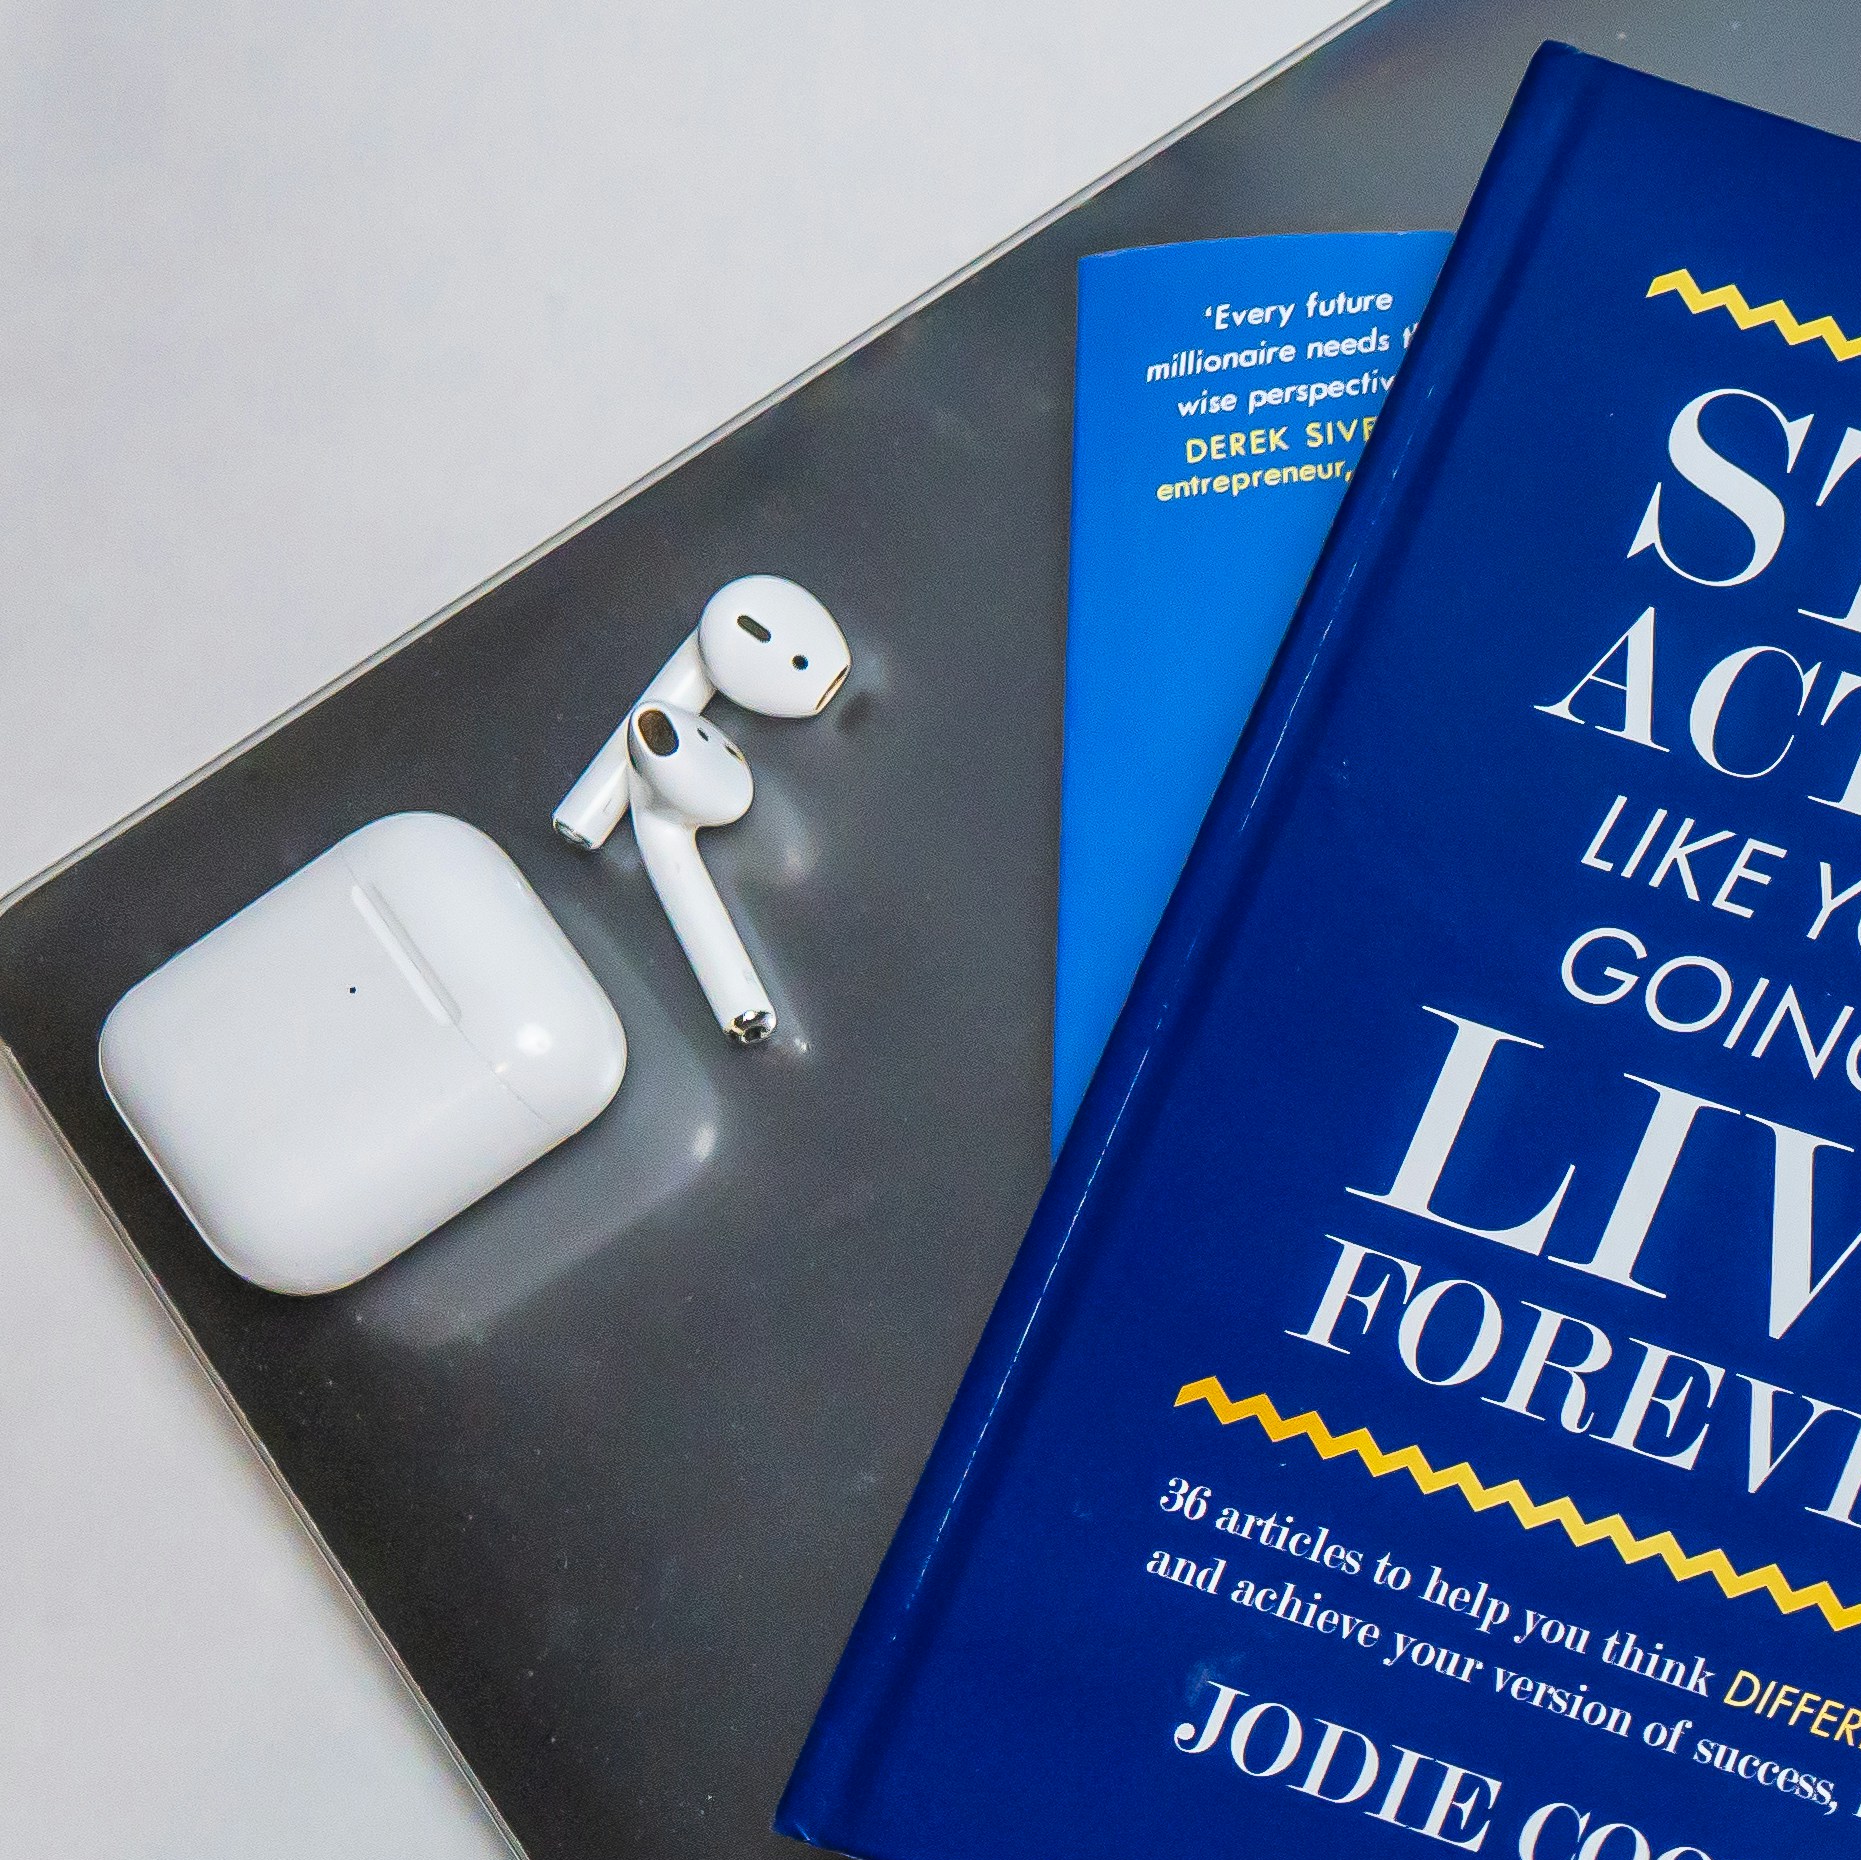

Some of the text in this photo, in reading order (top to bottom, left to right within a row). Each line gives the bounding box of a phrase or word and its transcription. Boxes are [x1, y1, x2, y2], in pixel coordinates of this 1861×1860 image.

[1306, 291, 1393, 318] future
[1146, 340, 1296, 383] millionaire
[1306, 327, 1391, 359] needs
[1178, 369, 1397, 417] wise perspectiv
[1185, 427, 1290, 463] DEREK
[1581, 795, 1788, 919] LIKE
[1159, 1475, 1211, 1522] 36
[1215, 1507, 1362, 1575] articles
[1377, 1552, 1412, 1591] to
[1422, 1565, 1511, 1632] help
[1514, 1607, 1592, 1655] you
[1602, 1629, 1716, 1699] think
[1145, 1548, 1220, 1595] and
[1230, 1577, 1382, 1650] achieve
[1383, 1630, 1487, 1685] your
[1493, 1667, 1638, 1738] version
[1642, 1716, 1688, 1755] of
[1692, 1735, 1839, 1815] success,
[1173, 1681, 1503, 1853] JODIE
